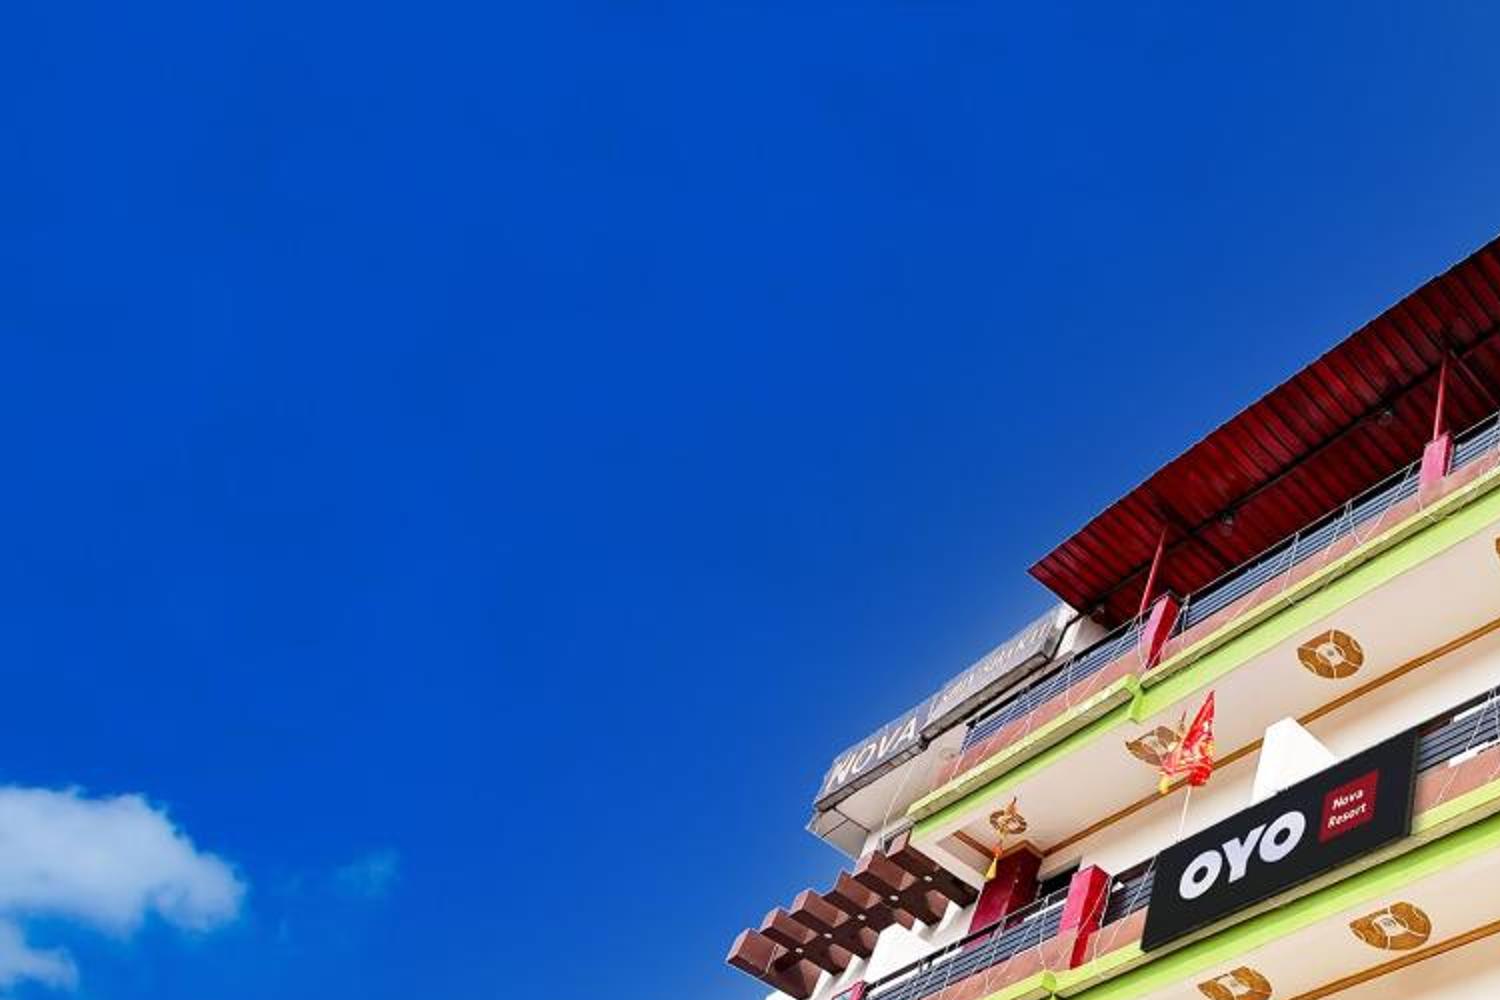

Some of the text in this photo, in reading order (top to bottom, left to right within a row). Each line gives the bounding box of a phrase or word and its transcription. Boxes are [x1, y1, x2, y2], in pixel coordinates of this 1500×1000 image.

[826, 717, 917, 789] NOVA
[1328, 803, 1367, 828] Resort
[1332, 789, 1363, 810] Nova
[1179, 811, 1306, 900] OYO
